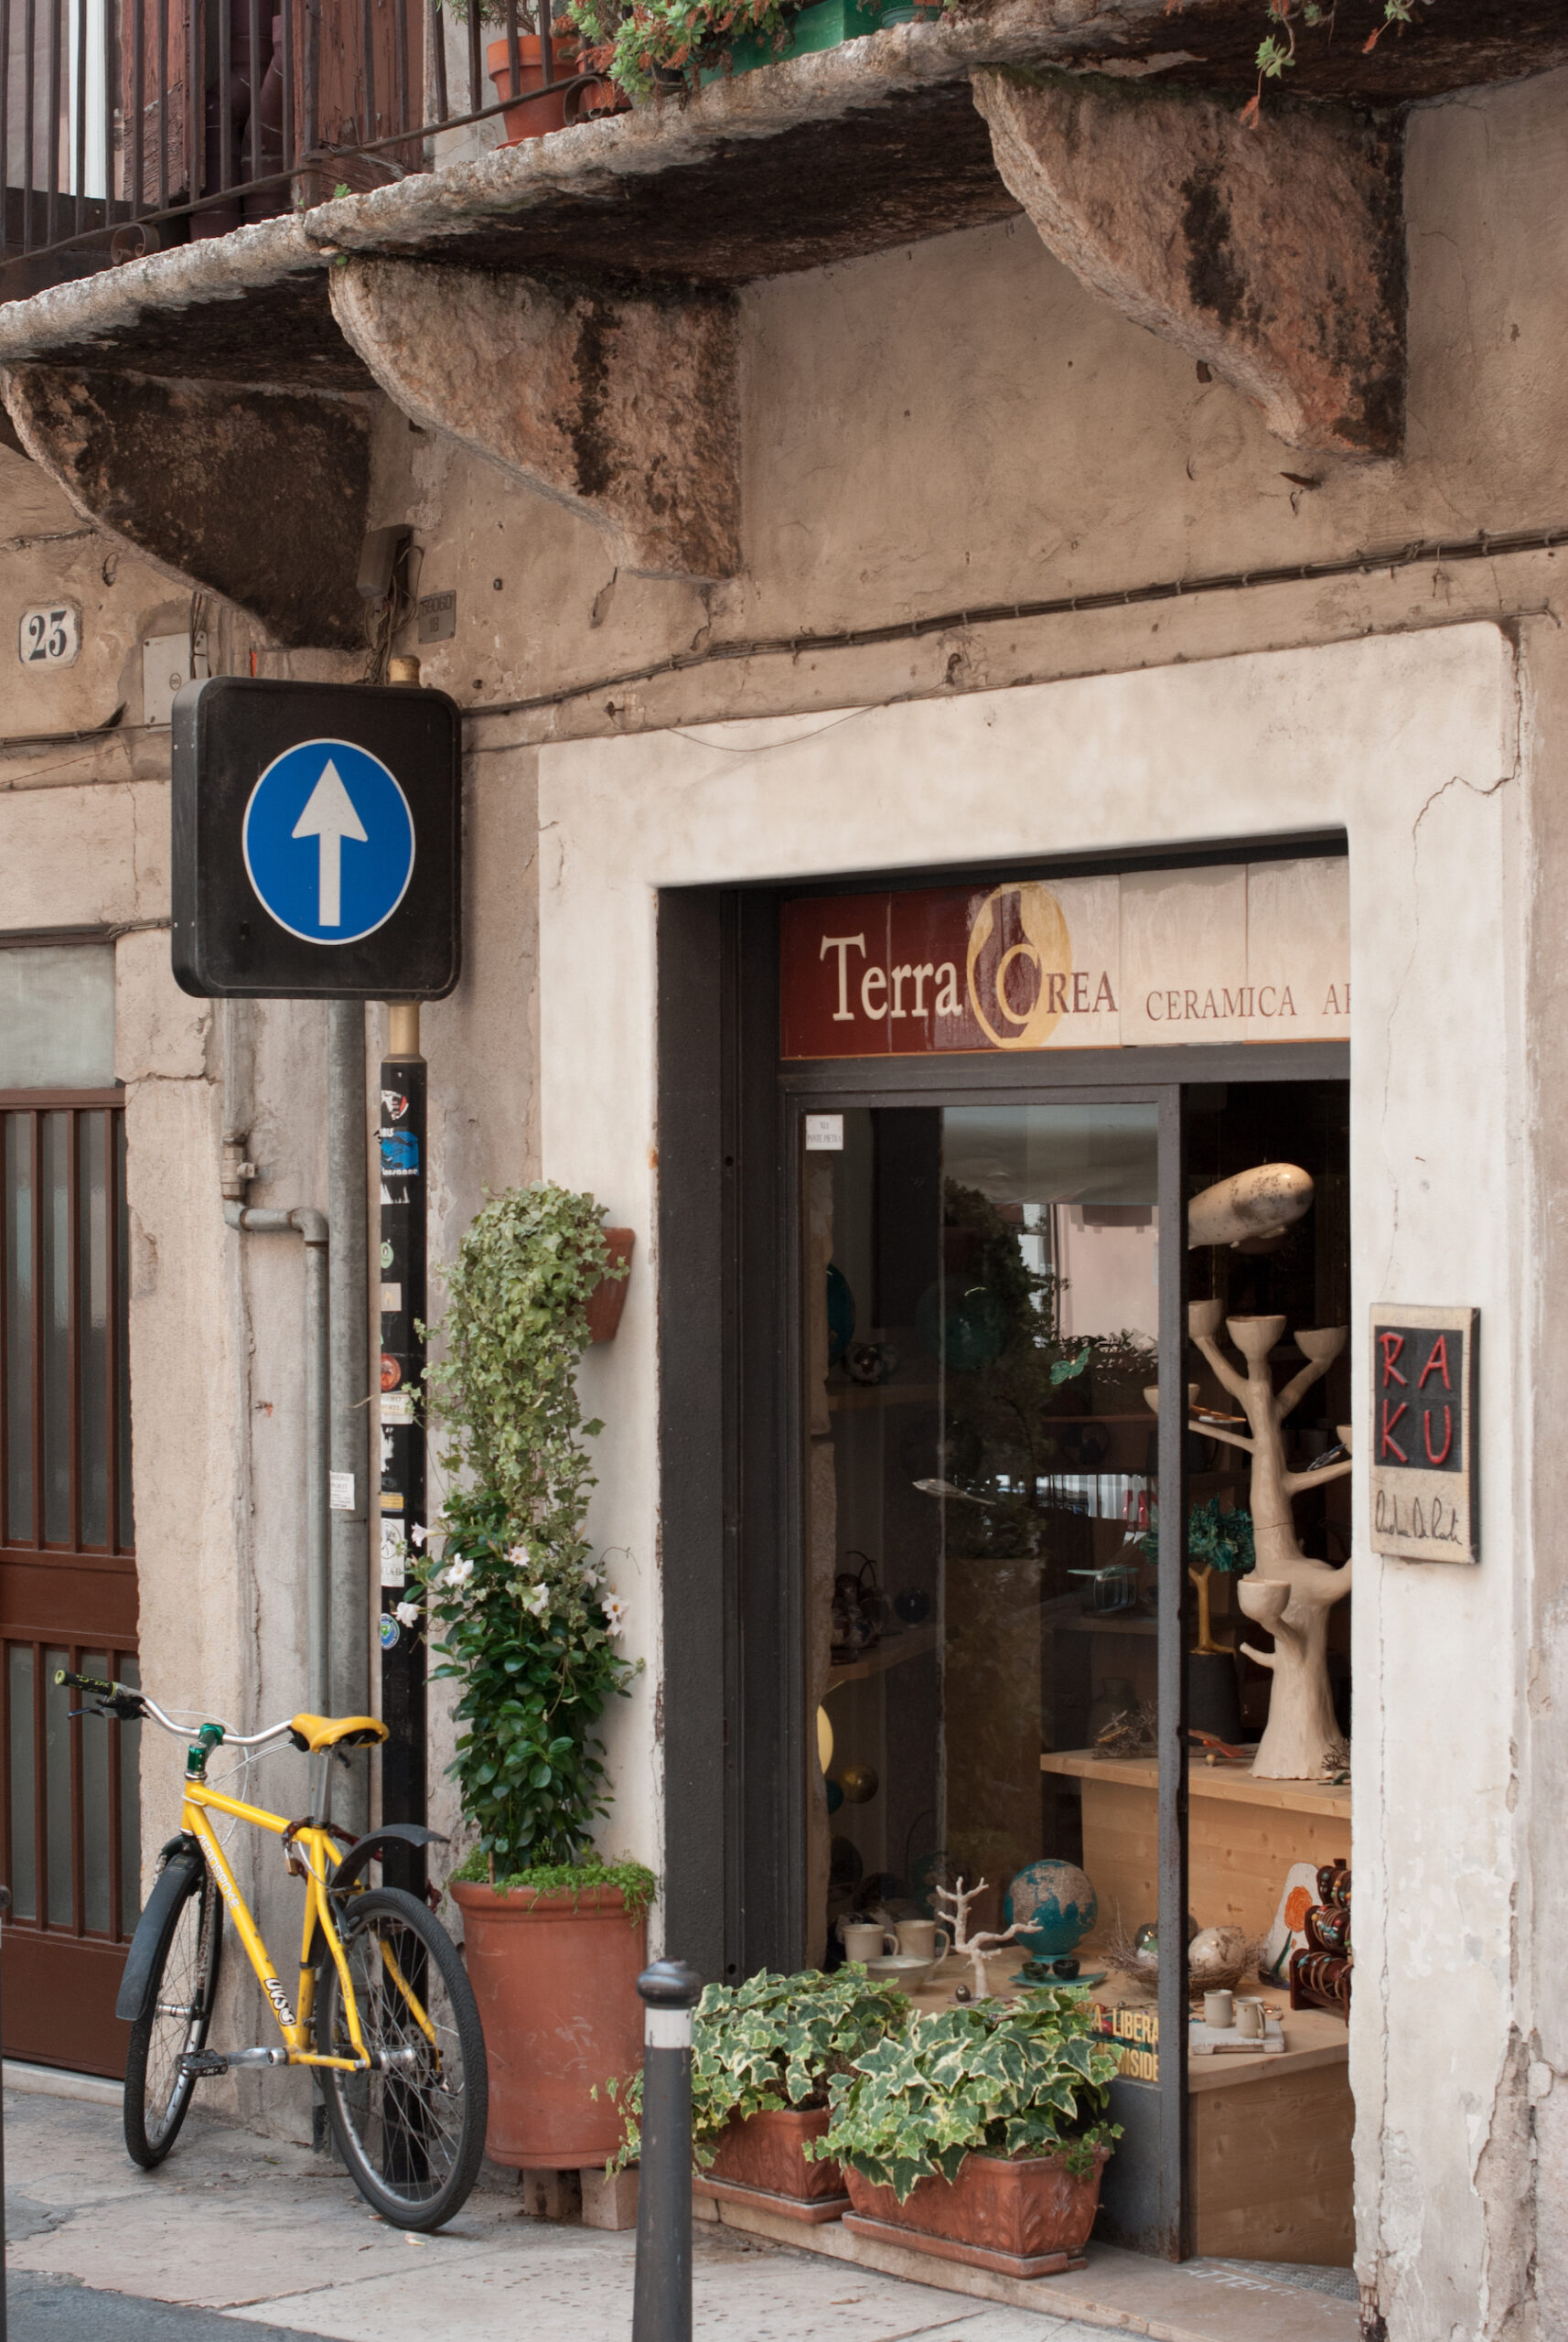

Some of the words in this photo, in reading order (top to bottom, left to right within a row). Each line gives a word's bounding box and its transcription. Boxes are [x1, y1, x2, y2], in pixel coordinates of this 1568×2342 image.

[28, 610, 67, 661] 23
[820, 931, 962, 1021] Terra
[1145, 985, 1297, 1021] CERAMICA
